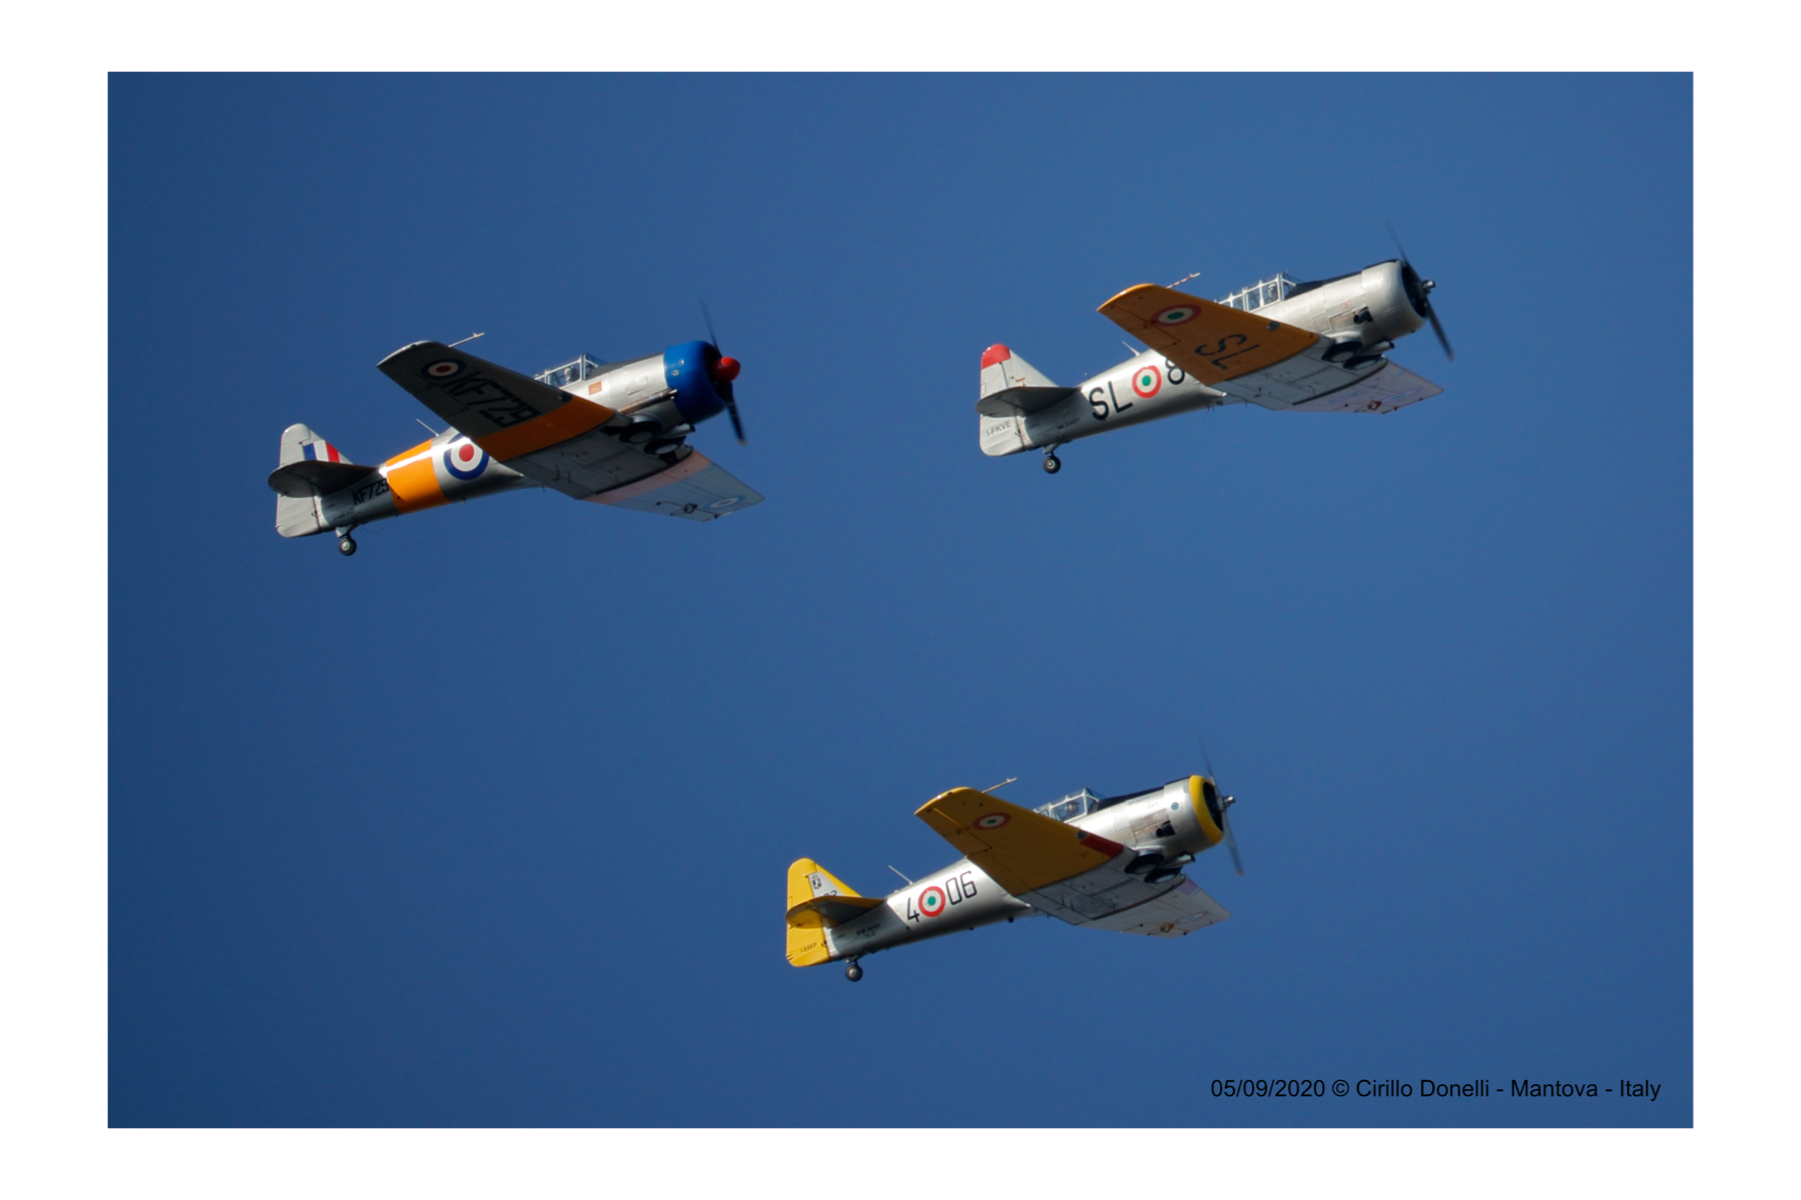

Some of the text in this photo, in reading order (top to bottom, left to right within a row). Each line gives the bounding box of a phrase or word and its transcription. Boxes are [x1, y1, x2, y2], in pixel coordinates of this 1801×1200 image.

[1195, 333, 1260, 370] SL
[441, 370, 542, 429] KF729
[1088, 381, 1133, 421] SL
[352, 478, 390, 506] KF729
[906, 870, 978, 923] 4 06
